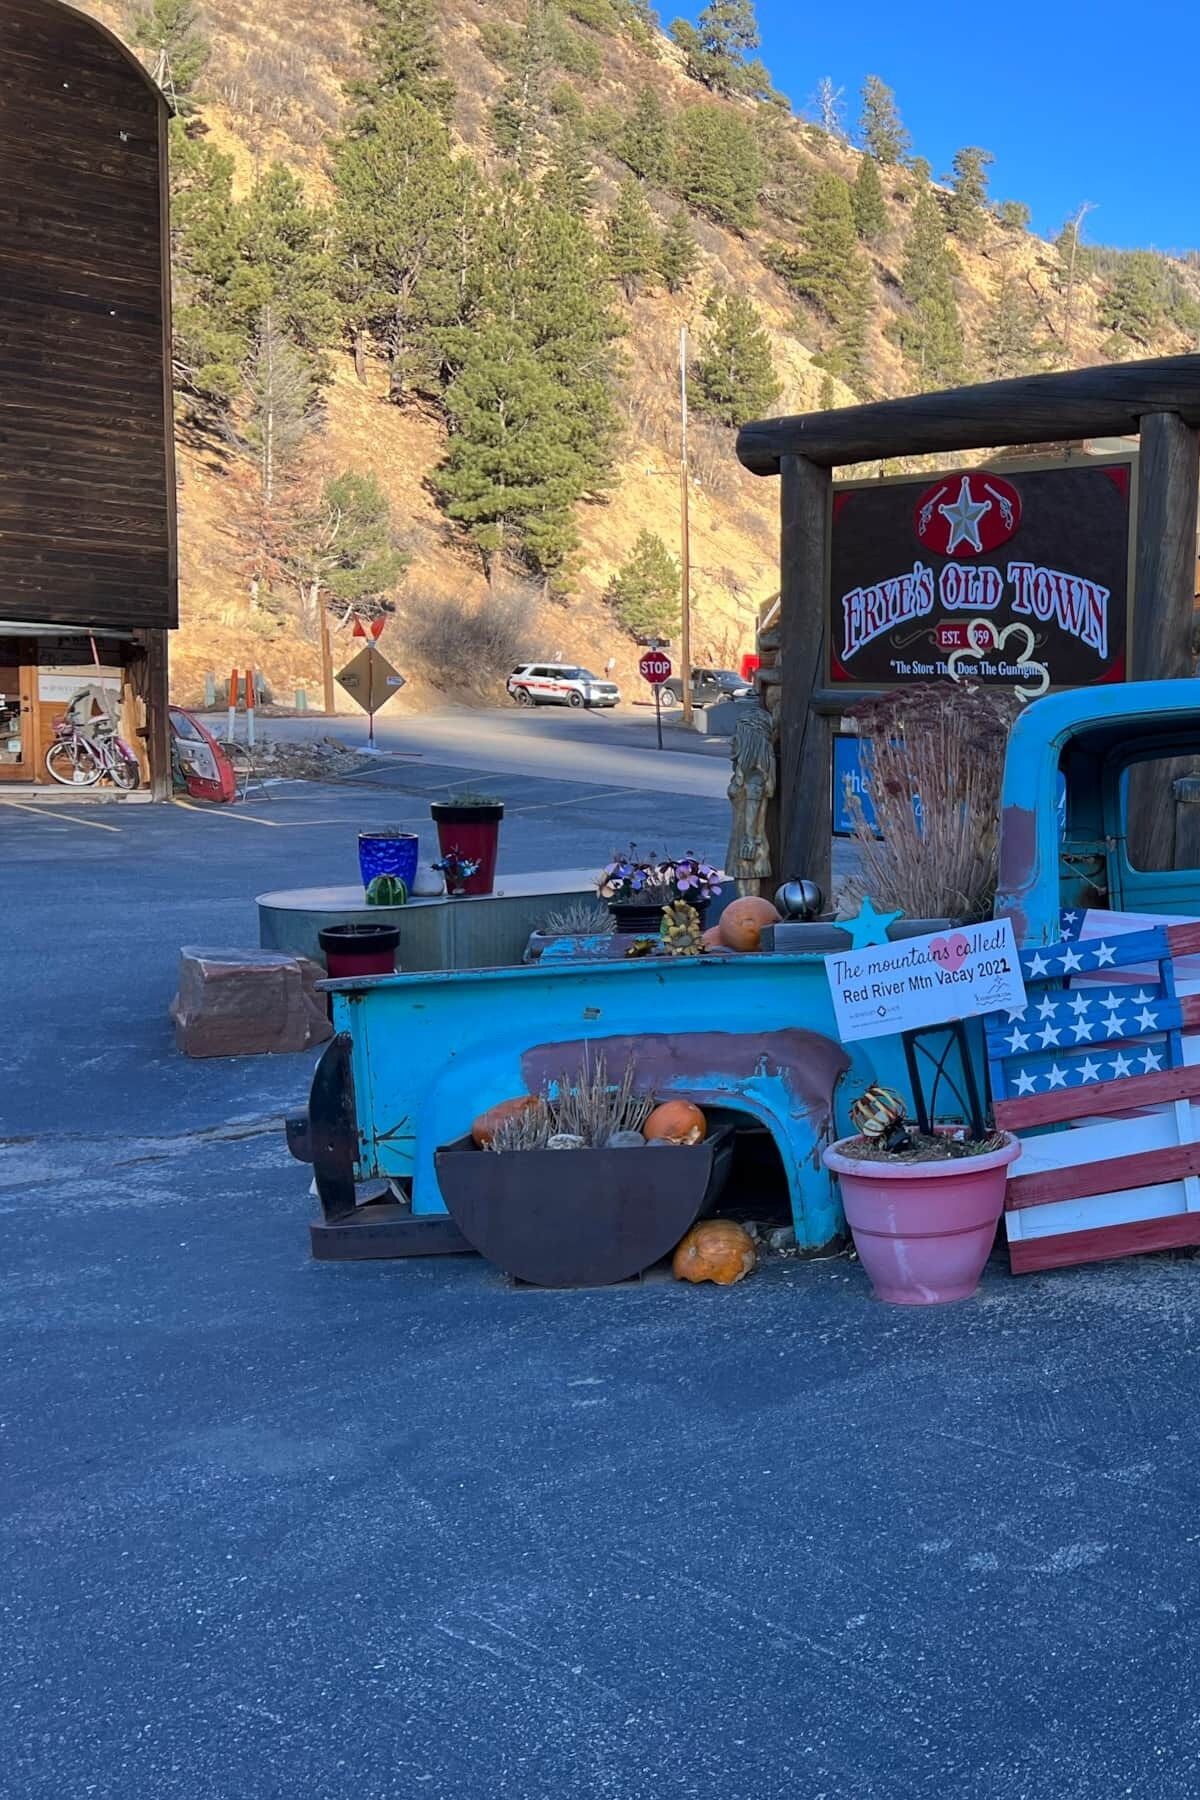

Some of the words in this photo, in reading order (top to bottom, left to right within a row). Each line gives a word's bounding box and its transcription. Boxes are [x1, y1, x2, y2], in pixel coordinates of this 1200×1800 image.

[841, 561, 934, 661] FRYE'S
[939, 562, 1004, 610] OLD
[1007, 562, 1110, 659] TOWN
[941, 630, 961, 645] EST.
[641, 661, 670, 674] STOP
[912, 661, 935, 674] Store
[957, 662, 978, 675] Does
[979, 661, 997, 675] The
[833, 961, 863, 985] The
[868, 946, 950, 975] mountains
[955, 927, 1007, 957] called!
[843, 986, 869, 1004] Red
[872, 980, 905, 999] River
[908, 974, 933, 992] Mtn
[935, 967, 974, 985] Vacay
